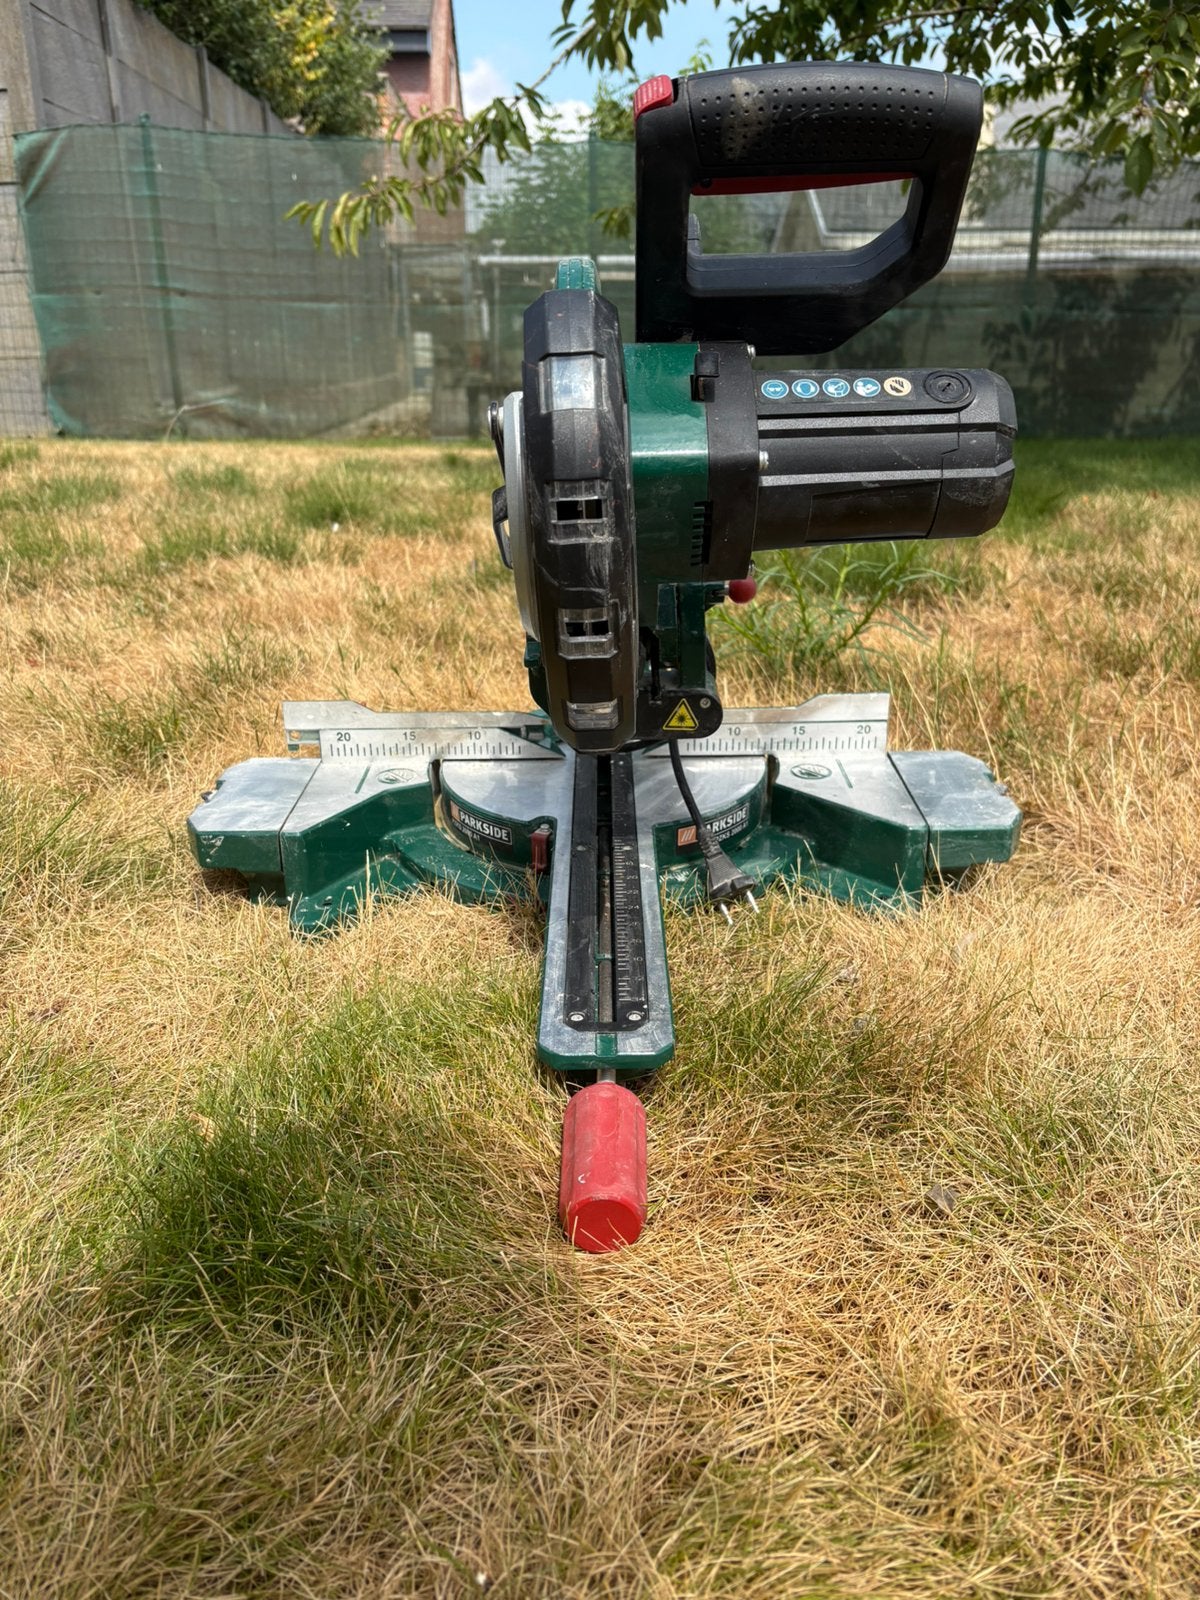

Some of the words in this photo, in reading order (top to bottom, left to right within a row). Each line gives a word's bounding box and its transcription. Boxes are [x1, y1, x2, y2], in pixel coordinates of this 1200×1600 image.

[336, 731, 351, 742] 20
[403, 730, 417, 741] 15
[468, 730, 481, 741] 10
[728, 726, 741, 737] 10
[792, 725, 806, 736] 15
[856, 724, 871, 735] 20
[460, 811, 509, 841] PARKSIDE
[705, 806, 747, 833] ARKSIDE
